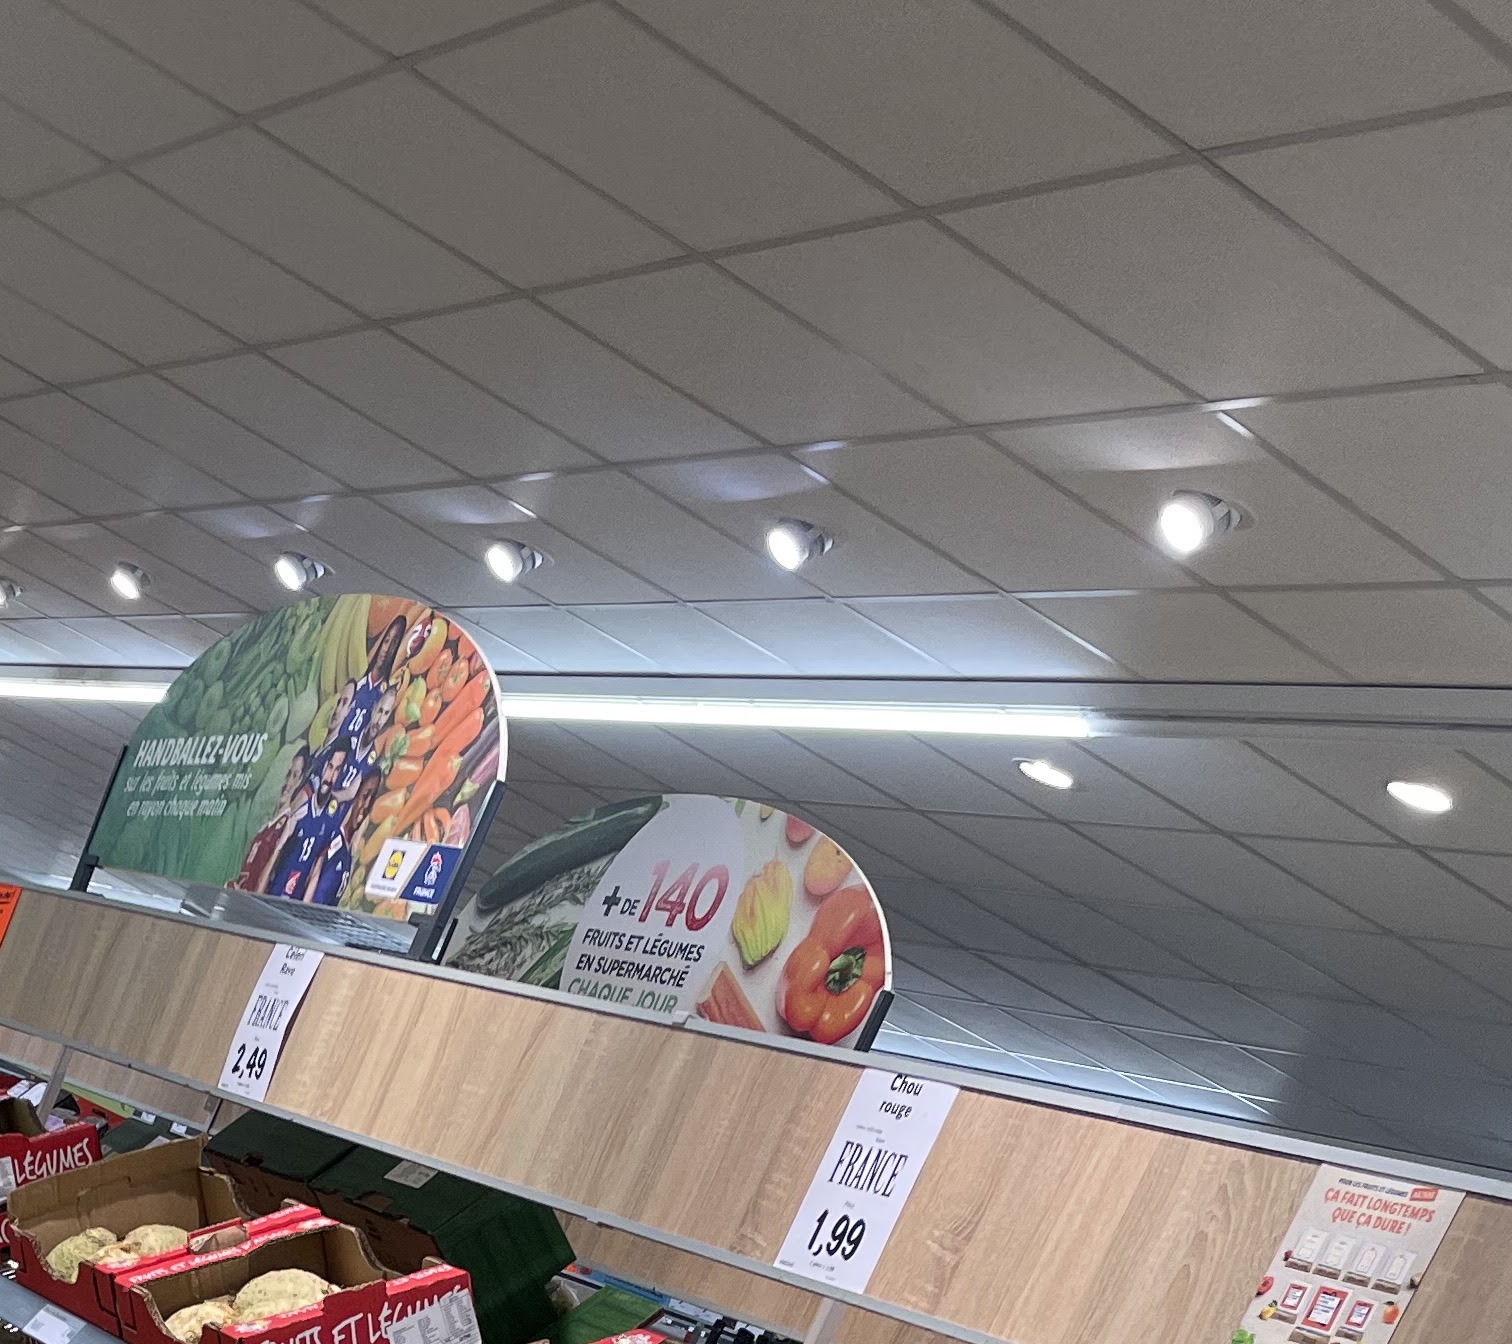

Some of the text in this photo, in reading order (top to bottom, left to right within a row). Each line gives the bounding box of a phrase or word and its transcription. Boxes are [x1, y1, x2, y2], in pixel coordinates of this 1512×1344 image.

[133, 732, 269, 768] HANDBALLEZ-VOUS
[141, 774, 153, 792] les
[151, 771, 180, 796] fruits
[181, 775, 192, 790] et
[191, 770, 231, 795] légumes
[232, 771, 253, 790] mis
[164, 799, 196, 820] chaque
[197, 798, 228, 817] matin
[602, 858, 730, 932] + DE 140
[582, 928, 706, 963] FRUITS ET LÉGUMES
[576, 953, 691, 988] EN SUPERMARCHÉ
[246, 994, 290, 1031] FRANCE
[568, 977, 679, 1014] CHAQUE JOUR
[231, 1043, 268, 1081] 2,49
[890, 1073, 925, 1097] Chou
[879, 1100, 913, 1120] rouge
[13, 1138, 93, 1182] LÉGUMES
[827, 1140, 909, 1198] FRANCE
[1324, 1187, 1437, 1224] ÇA FAIT LONGTEMPS
[1331, 1206, 1354, 1224] QUE
[1355, 1210, 1372, 1229] ÇA
[1371, 1214, 1404, 1235] DURE
[807, 1209, 867, 1262] 1,99
[129, 1268, 170, 1286] FRUITS
[170, 1261, 187, 1276] ET
